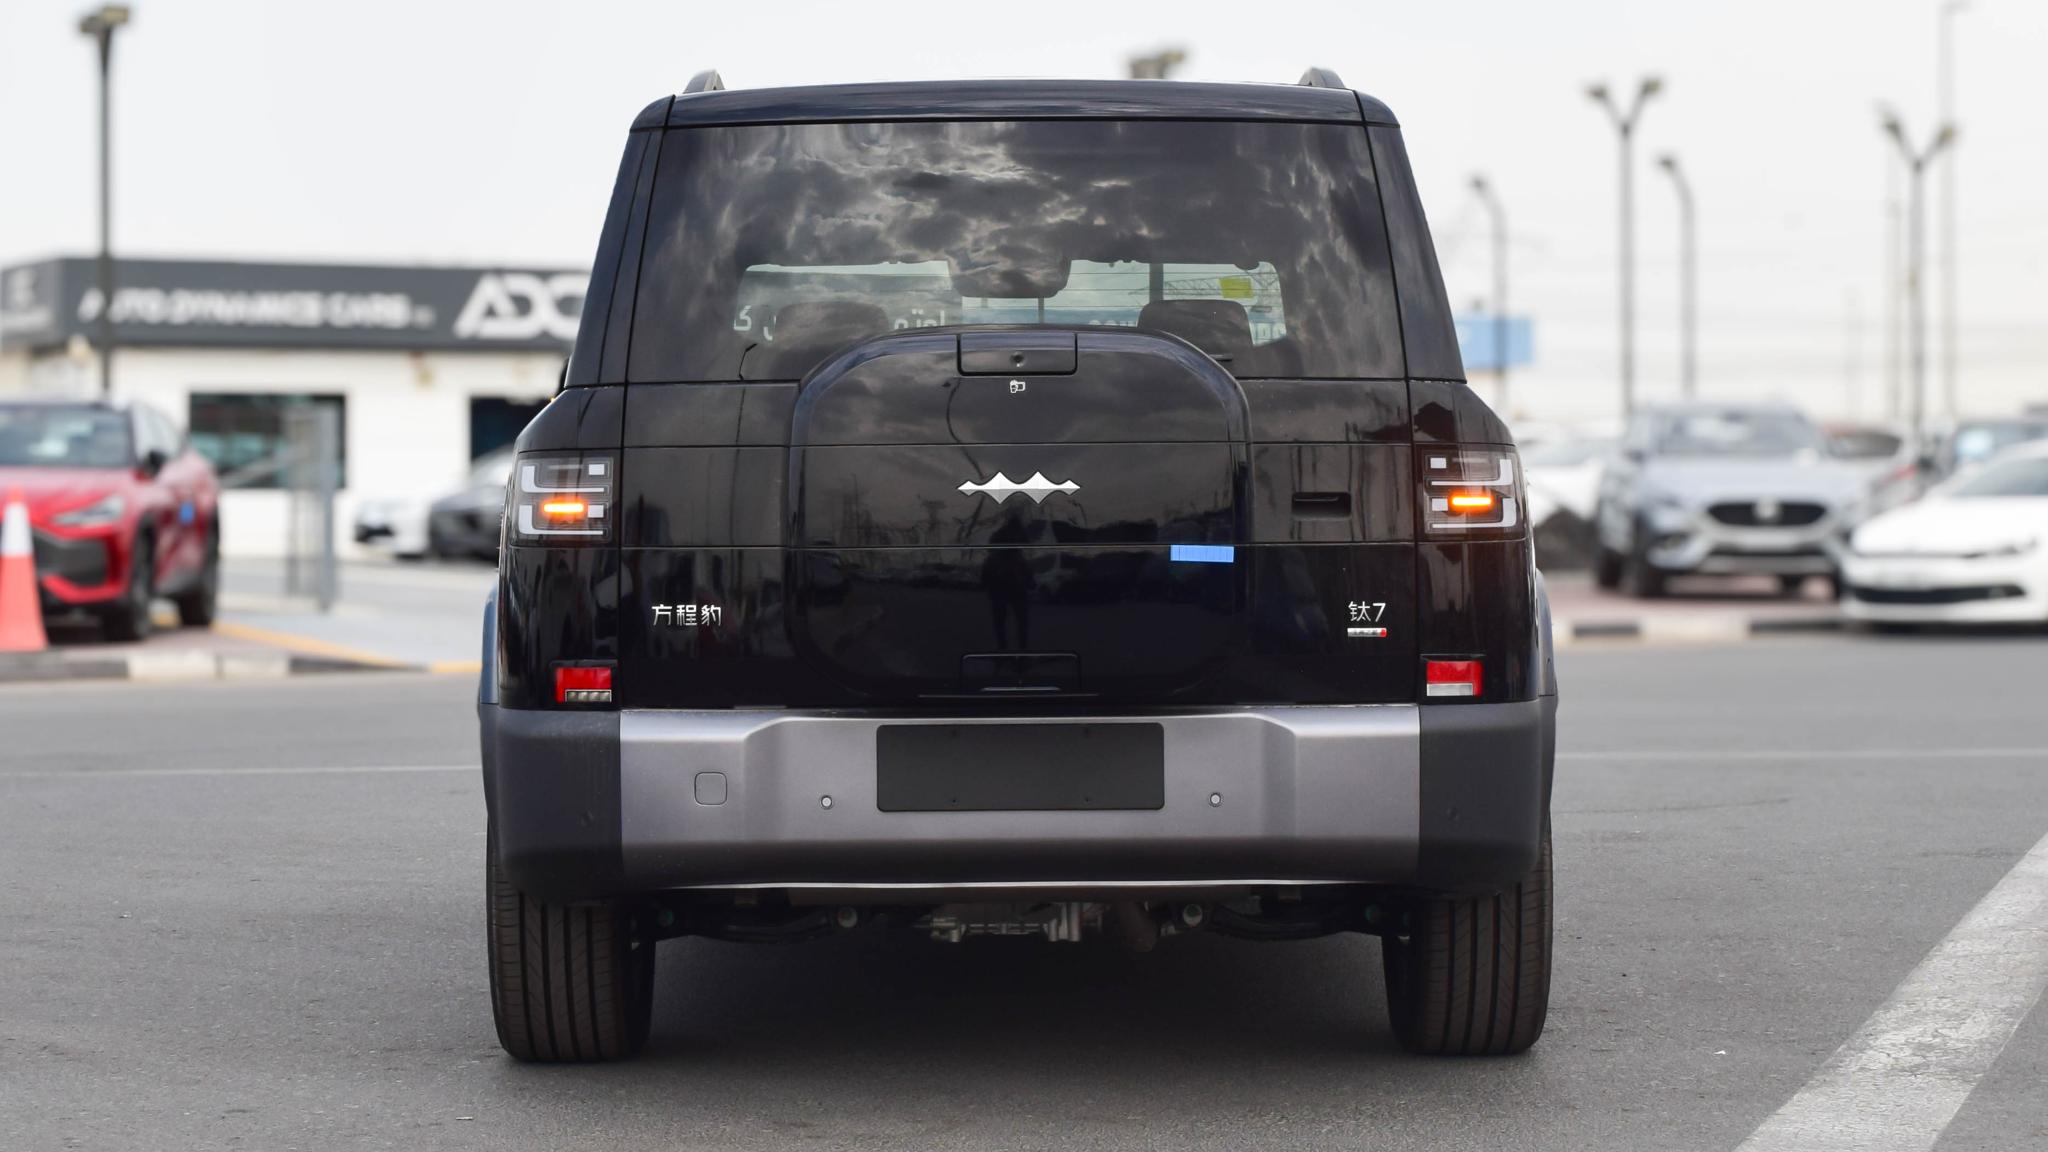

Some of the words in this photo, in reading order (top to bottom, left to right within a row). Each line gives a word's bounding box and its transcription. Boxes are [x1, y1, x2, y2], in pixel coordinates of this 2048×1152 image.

[651, 604, 721, 626] 方程豹
[1348, 601, 1386, 622] 钛7
